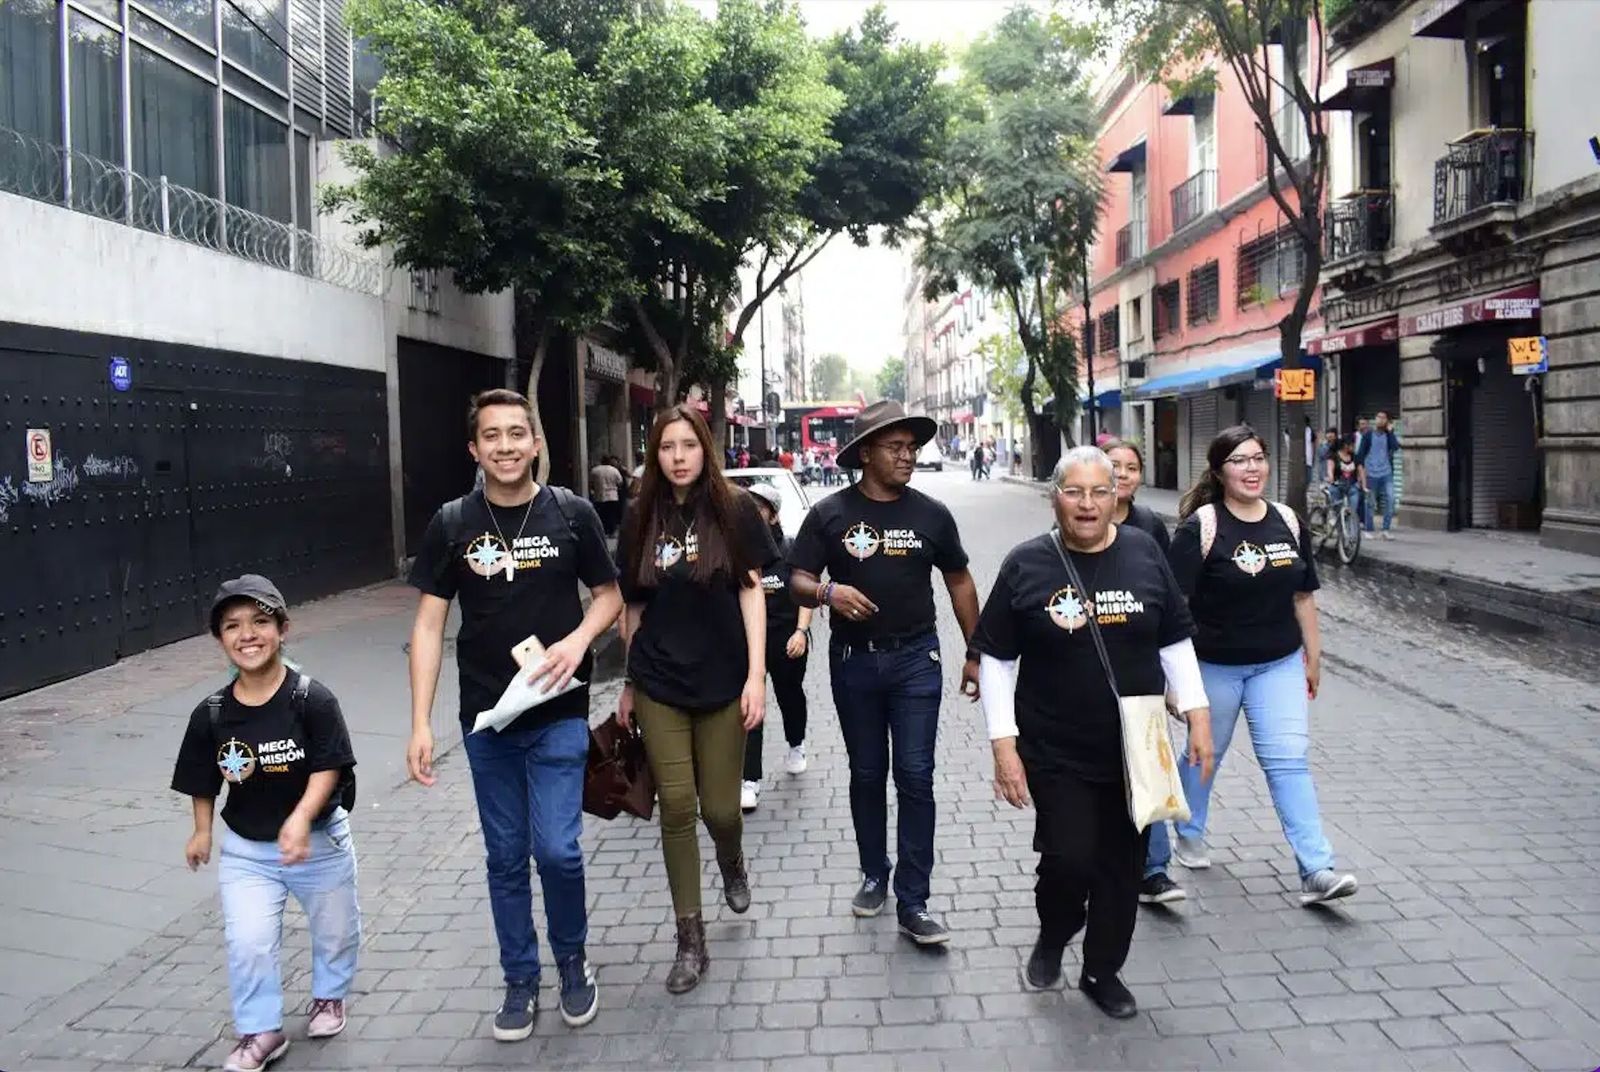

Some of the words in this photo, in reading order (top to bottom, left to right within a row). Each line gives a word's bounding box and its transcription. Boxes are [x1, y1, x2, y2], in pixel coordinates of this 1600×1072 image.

[1416, 312, 1443, 332] CRAZY
[1443, 307, 1464, 327] RIBS
[883, 529, 916, 539] MEGA
[512, 536, 551, 548] MEGA
[883, 538, 923, 549] MISIÓN
[1265, 543, 1291, 552] MEGA
[513, 545, 559, 560] MISIÓN
[1268, 550, 1299, 560] MISIÓN
[1095, 590, 1134, 602] MEGA
[1096, 600, 1144, 615] MISIÓN
[1097, 614, 1127, 624] CDMX
[258, 738, 297, 753] MEGA
[260, 748, 306, 765] MISIÓN
[263, 764, 289, 772] CDMX
